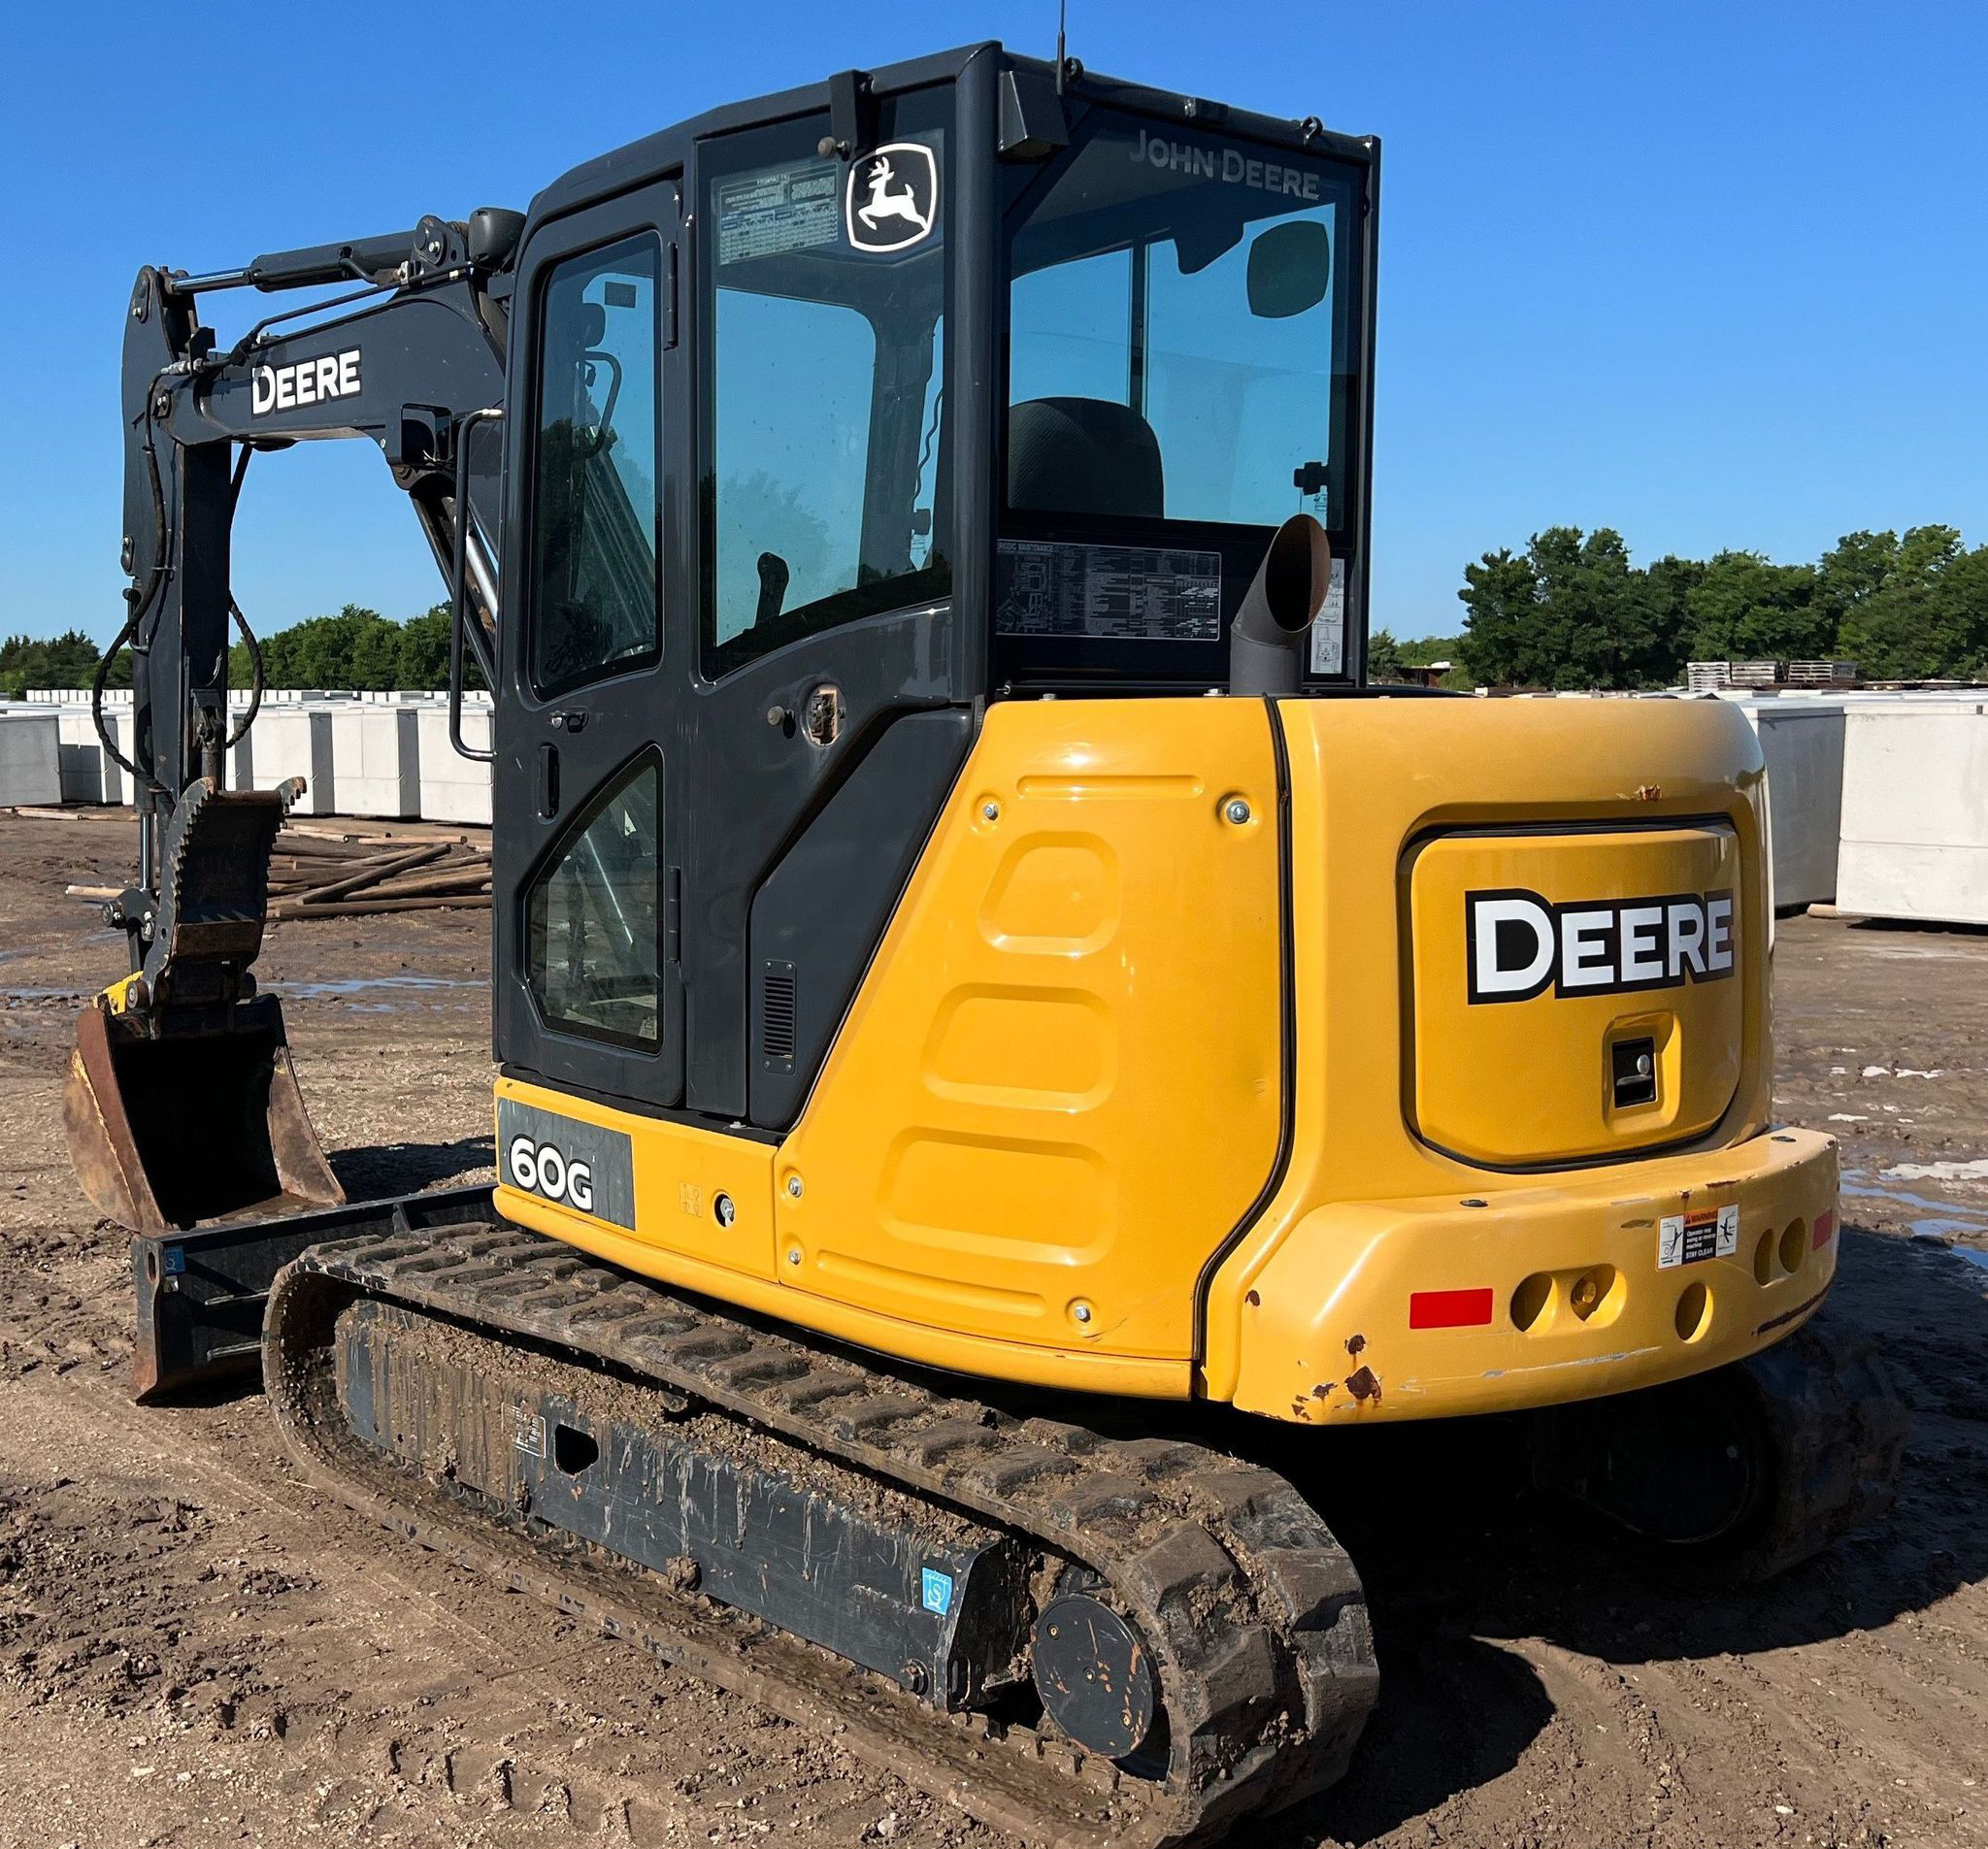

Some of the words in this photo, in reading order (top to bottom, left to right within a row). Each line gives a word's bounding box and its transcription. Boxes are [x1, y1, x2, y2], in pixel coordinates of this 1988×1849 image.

[1129, 129, 1213, 179] JOHN
[1222, 148, 1320, 201] DEERE
[252, 349, 361, 414] DEERE
[1474, 899, 1733, 993] DEERE
[511, 1136, 594, 1211] 60G
[1698, 1247, 1714, 1257] CLEAR
